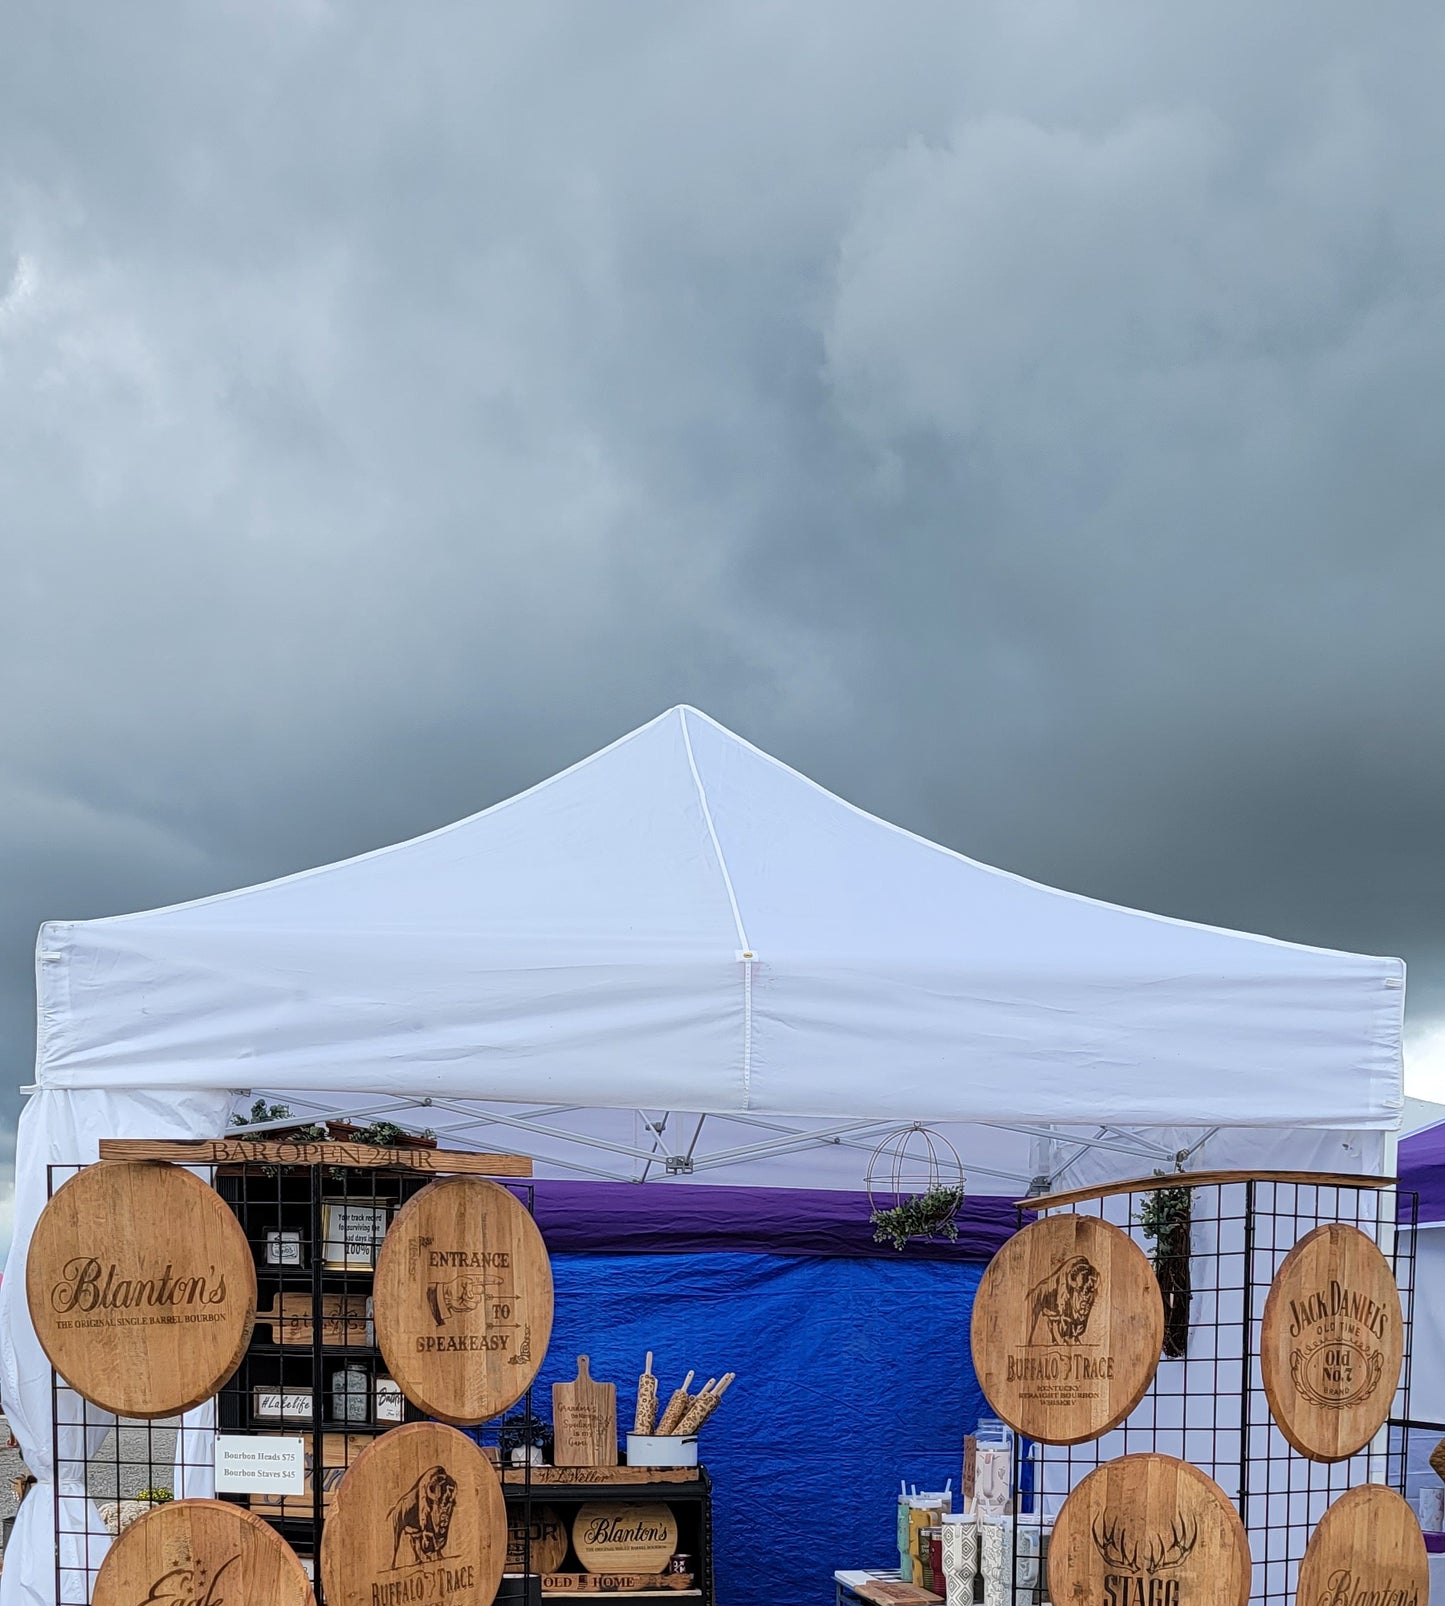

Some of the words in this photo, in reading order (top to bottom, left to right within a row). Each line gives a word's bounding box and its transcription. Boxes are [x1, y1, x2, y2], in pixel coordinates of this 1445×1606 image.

[209, 1141, 268, 1162] BAR
[277, 1143, 360, 1164] OPEN
[368, 1147, 436, 1169] 24HR
[428, 1251, 510, 1268] ENTRANCE
[51, 1256, 226, 1313] Blanton's
[492, 1304, 510, 1319] TO
[1289, 1290, 1328, 1337] JACK
[1331, 1280, 1388, 1340] DANIEL'S
[56, 1320, 73, 1329] THE
[74, 1319, 116, 1328] ORIGINAL
[117, 1317, 149, 1327] SINGLE
[149, 1315, 183, 1325] BARREL
[185, 1313, 226, 1324] BOURBON
[1317, 1322, 1335, 1336] OLD
[1340, 1321, 1361, 1337] TIME
[416, 1335, 510, 1352] SPEAKEASY
[1325, 1350, 1350, 1366] Old
[1006, 1354, 1058, 1382] BUFFALO
[1073, 1354, 1114, 1380] TRACE
[1324, 1386, 1350, 1395] BRAND
[224, 1451, 256, 1460] Bourbon
[258, 1452, 280, 1461] Heads
[282, 1453, 296, 1461] $75
[224, 1468, 256, 1477] Bourbon
[257, 1469, 280, 1478] Staves
[282, 1470, 296, 1478] $45
[584, 1517, 667, 1544] Blanton's
[438, 1565, 474, 1598] TRACE
[543, 1577, 572, 1588] OLD
[593, 1577, 634, 1588] HOME
